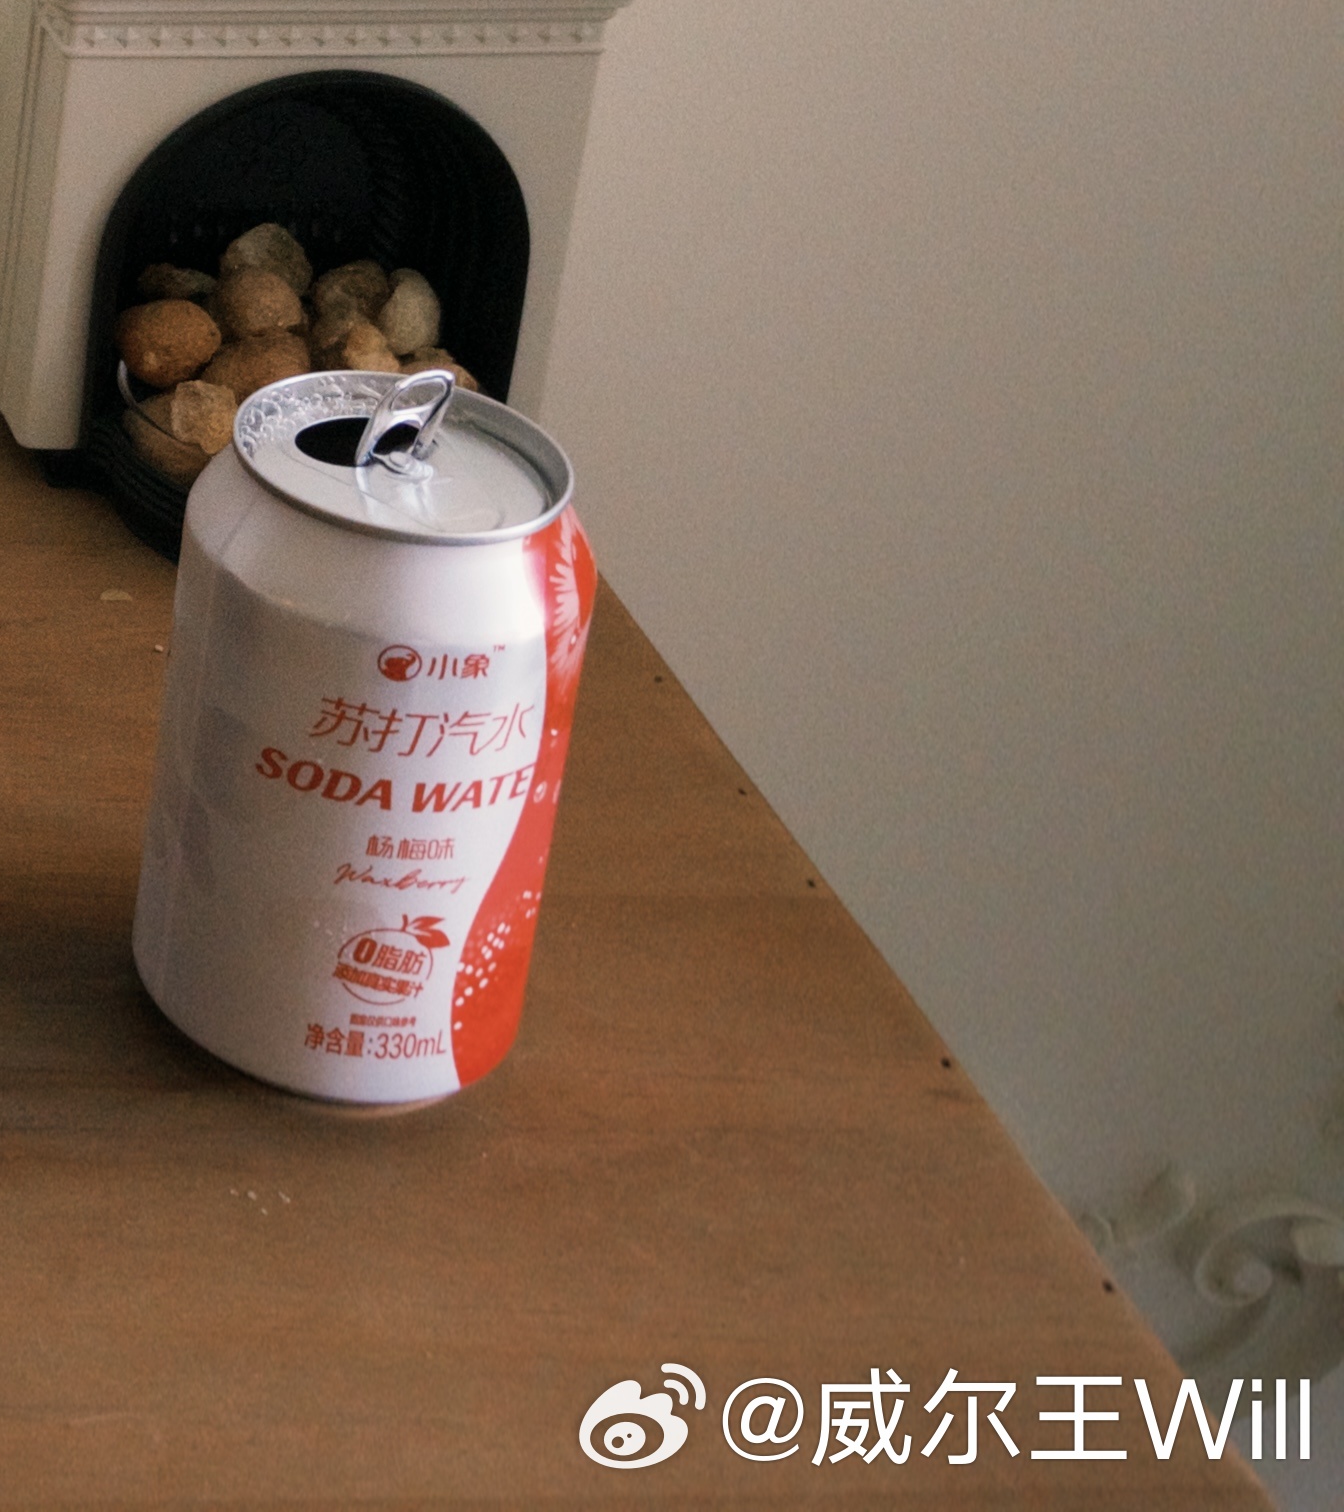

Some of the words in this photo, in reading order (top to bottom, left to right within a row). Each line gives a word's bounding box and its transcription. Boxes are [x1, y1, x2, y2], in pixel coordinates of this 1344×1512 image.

[427, 654, 490, 680] 小象
[309, 697, 535, 757] 苏打汽水
[255, 746, 393, 811] SODA
[365, 835, 455, 861] 杨梅味
